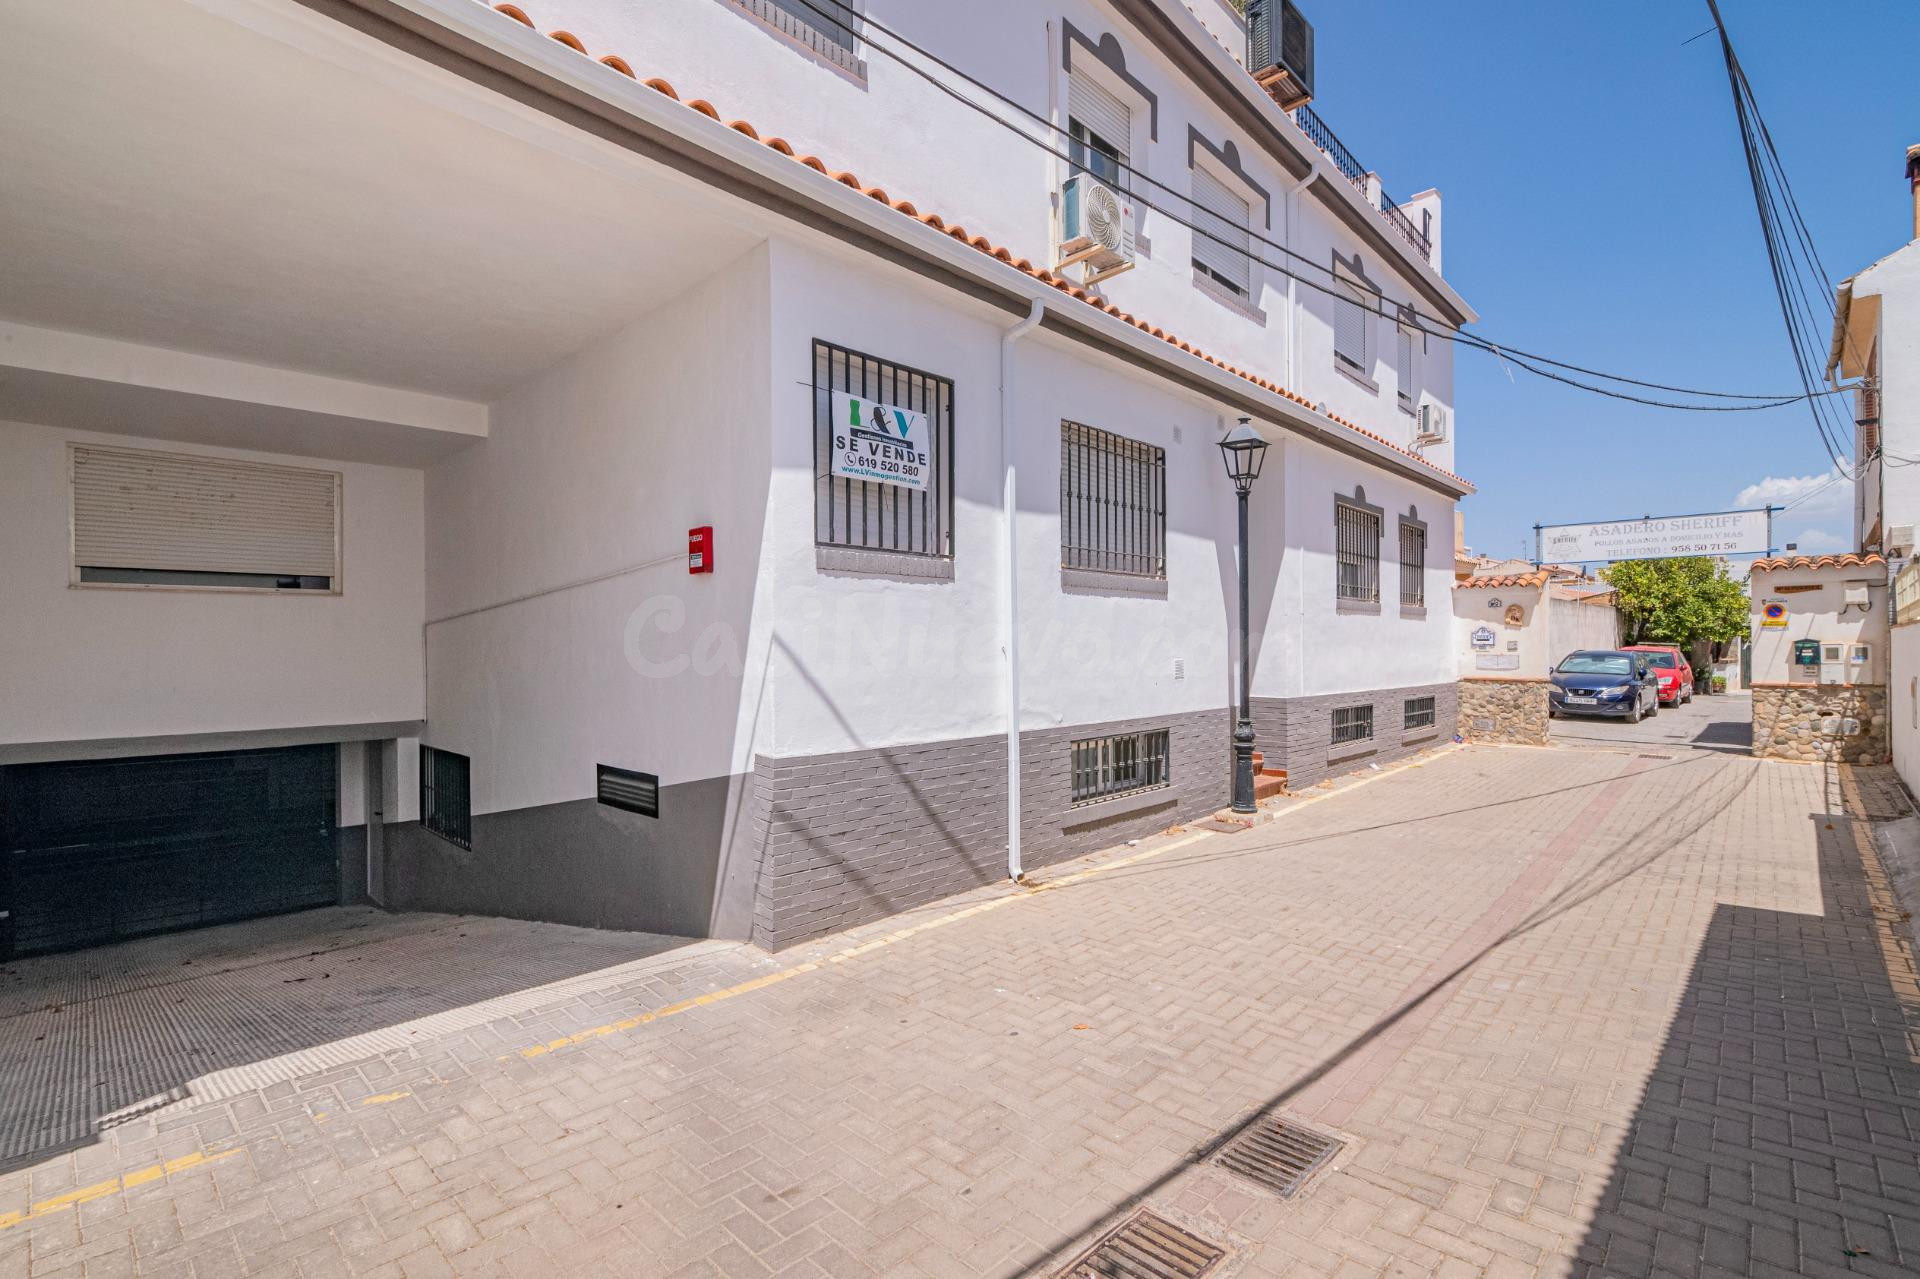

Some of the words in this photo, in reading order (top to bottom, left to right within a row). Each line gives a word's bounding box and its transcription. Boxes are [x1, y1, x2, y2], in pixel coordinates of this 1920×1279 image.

[836, 435, 858, 452] SE
[869, 442, 926, 466] VENDE
[858, 456, 877, 469] 619
[880, 460, 899, 473] 520
[902, 465, 919, 477] 580
[1589, 521, 1665, 537] ASADERO
[1670, 515, 1743, 531] SHERIFF
[1671, 543, 1691, 553] 958
[1693, 543, 1707, 552] 50
[1710, 543, 1720, 551] 71
[1723, 542, 1737, 550] 56
